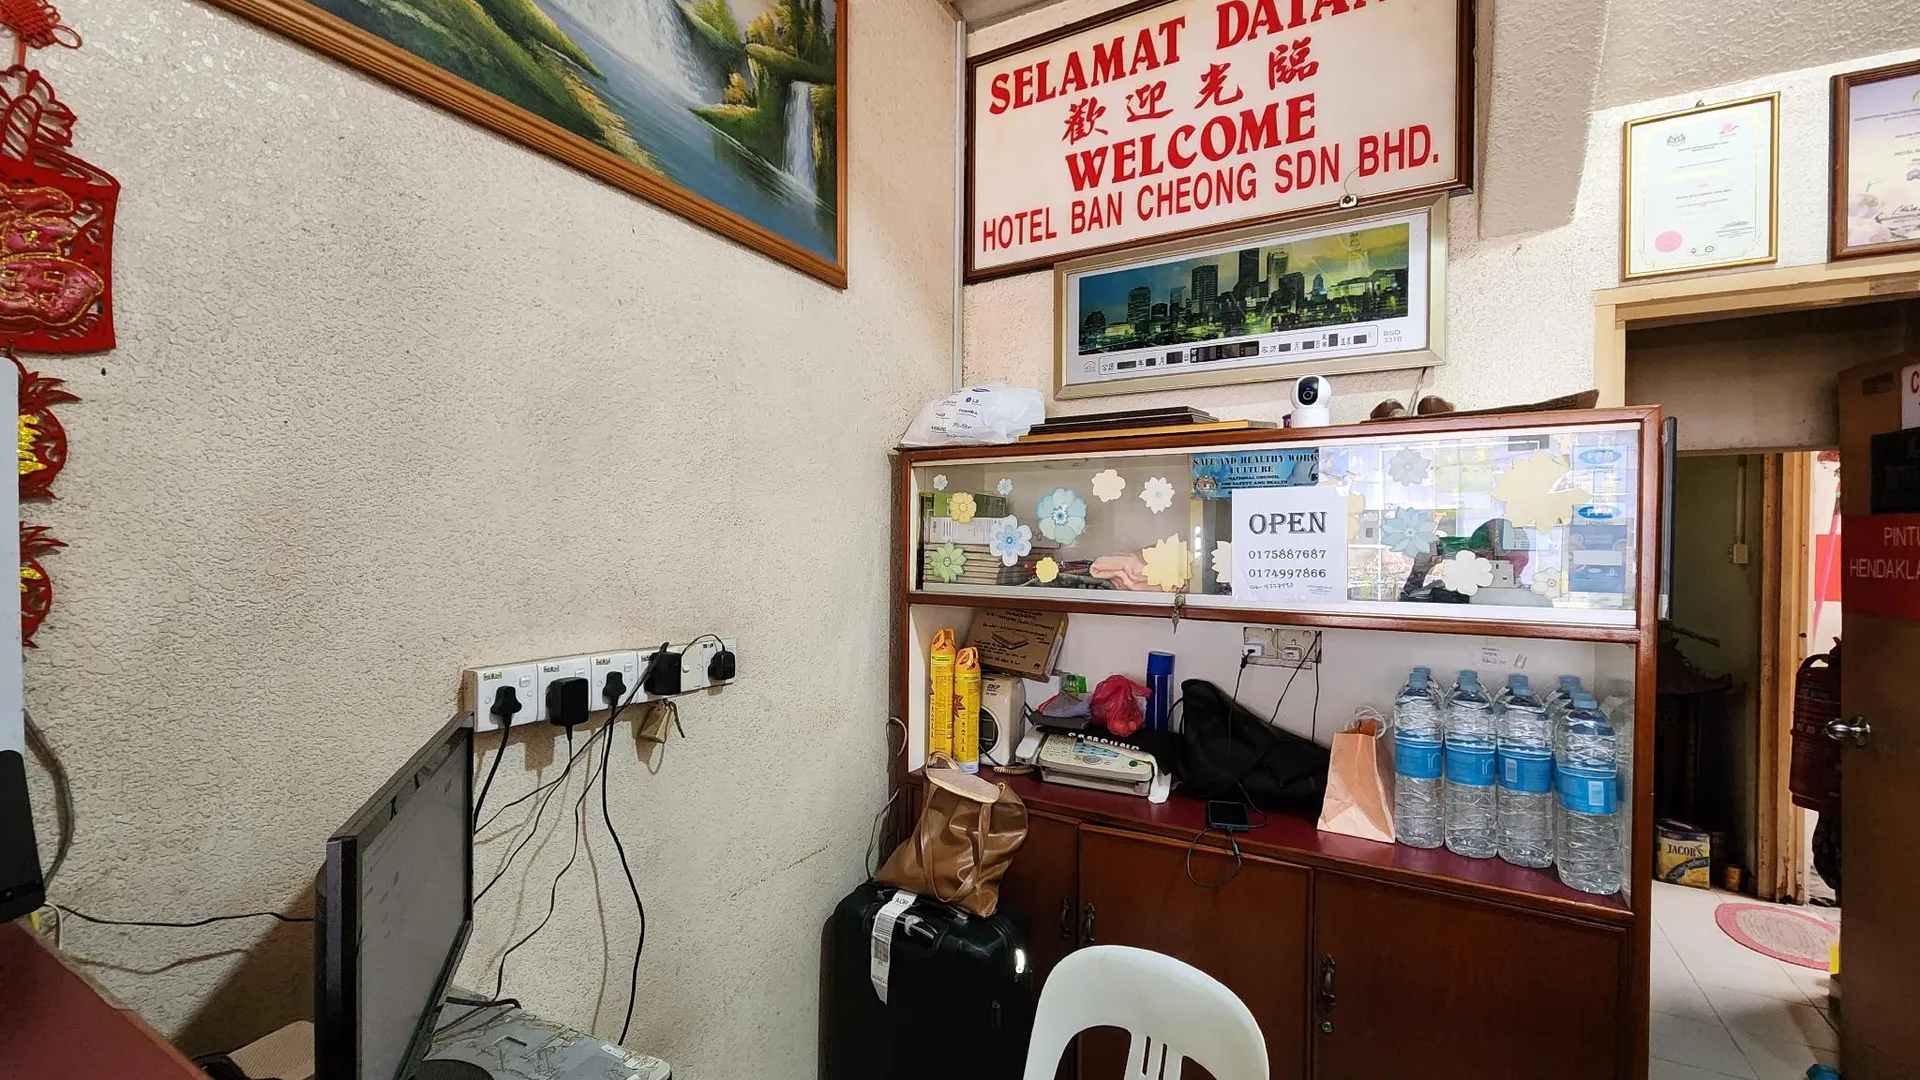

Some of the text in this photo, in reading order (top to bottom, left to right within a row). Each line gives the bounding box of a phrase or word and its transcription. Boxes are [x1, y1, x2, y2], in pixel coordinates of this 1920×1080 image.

[989, 16, 1186, 115] SELAMAT
[1061, 36, 1320, 146] 歡迎光臨
[1065, 93, 1316, 192] WELCOME
[982, 124, 1440, 252] HOTEL BAN CHEONG SDN BHD.
[1193, 457, 1216, 466] SAFE
[1220, 456, 1237, 465] AND
[1240, 454, 1284, 464] HEALTHY
[1230, 465, 1274, 474] CULTURE
[1248, 511, 1328, 535] OPEN
[1248, 549, 1327, 560] 0175887687
[1248, 568, 1327, 579] 0174997866
